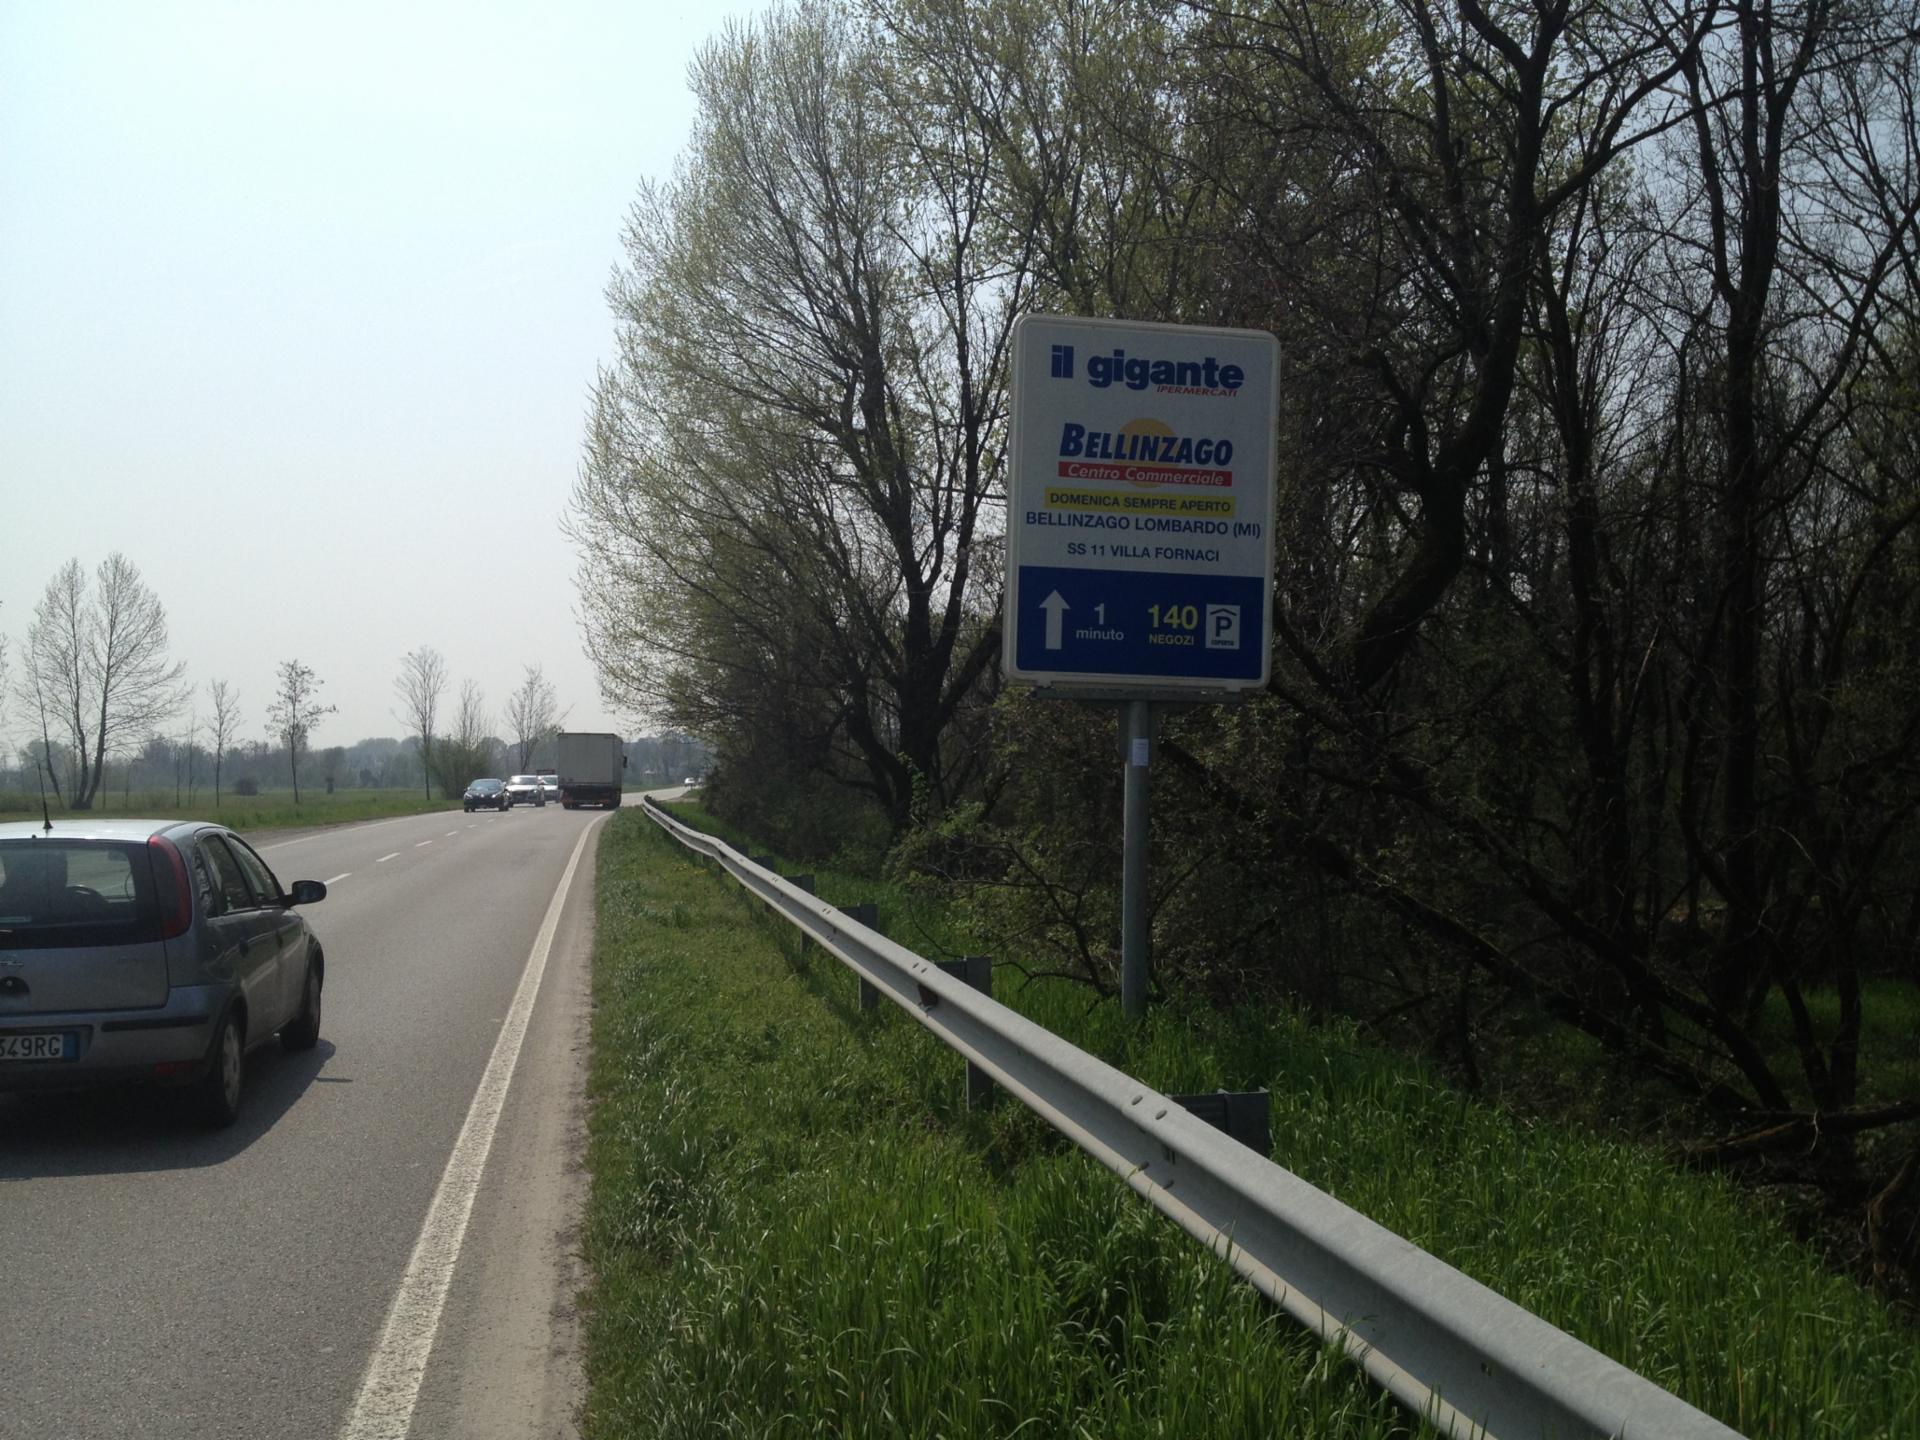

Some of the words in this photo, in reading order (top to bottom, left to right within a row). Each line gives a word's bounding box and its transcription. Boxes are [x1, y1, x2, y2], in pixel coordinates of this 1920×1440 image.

[1051, 345, 1074, 379] il
[1087, 349, 1245, 389] gigante
[1157, 385, 1238, 397] IPERMERCATI
[1060, 423, 1233, 466] BELLINZAGO
[1068, 464, 1120, 479] Centro
[1125, 468, 1224, 486] Commerciale
[1050, 493, 1120, 508] DOMENICA
[1123, 497, 1177, 510] SEMPRE
[1180, 499, 1231, 512] APERTO
[1026, 511, 1131, 529] BELLINZAGO
[1135, 517, 1228, 534] LOMBARDO
[1232, 522, 1261, 539] (MI)
[1067, 543, 1087, 556] SS
[1091, 544, 1106, 557] 11
[1110, 545, 1151, 558] VILLA
[1155, 548, 1219, 562] FORNACI
[1094, 603, 1105, 625] 1
[1148, 605, 1198, 629] 140
[1076, 627, 1124, 641] minuto
[1215, 616, 1233, 638] P
[1149, 633, 1194, 645] NEGOZI
